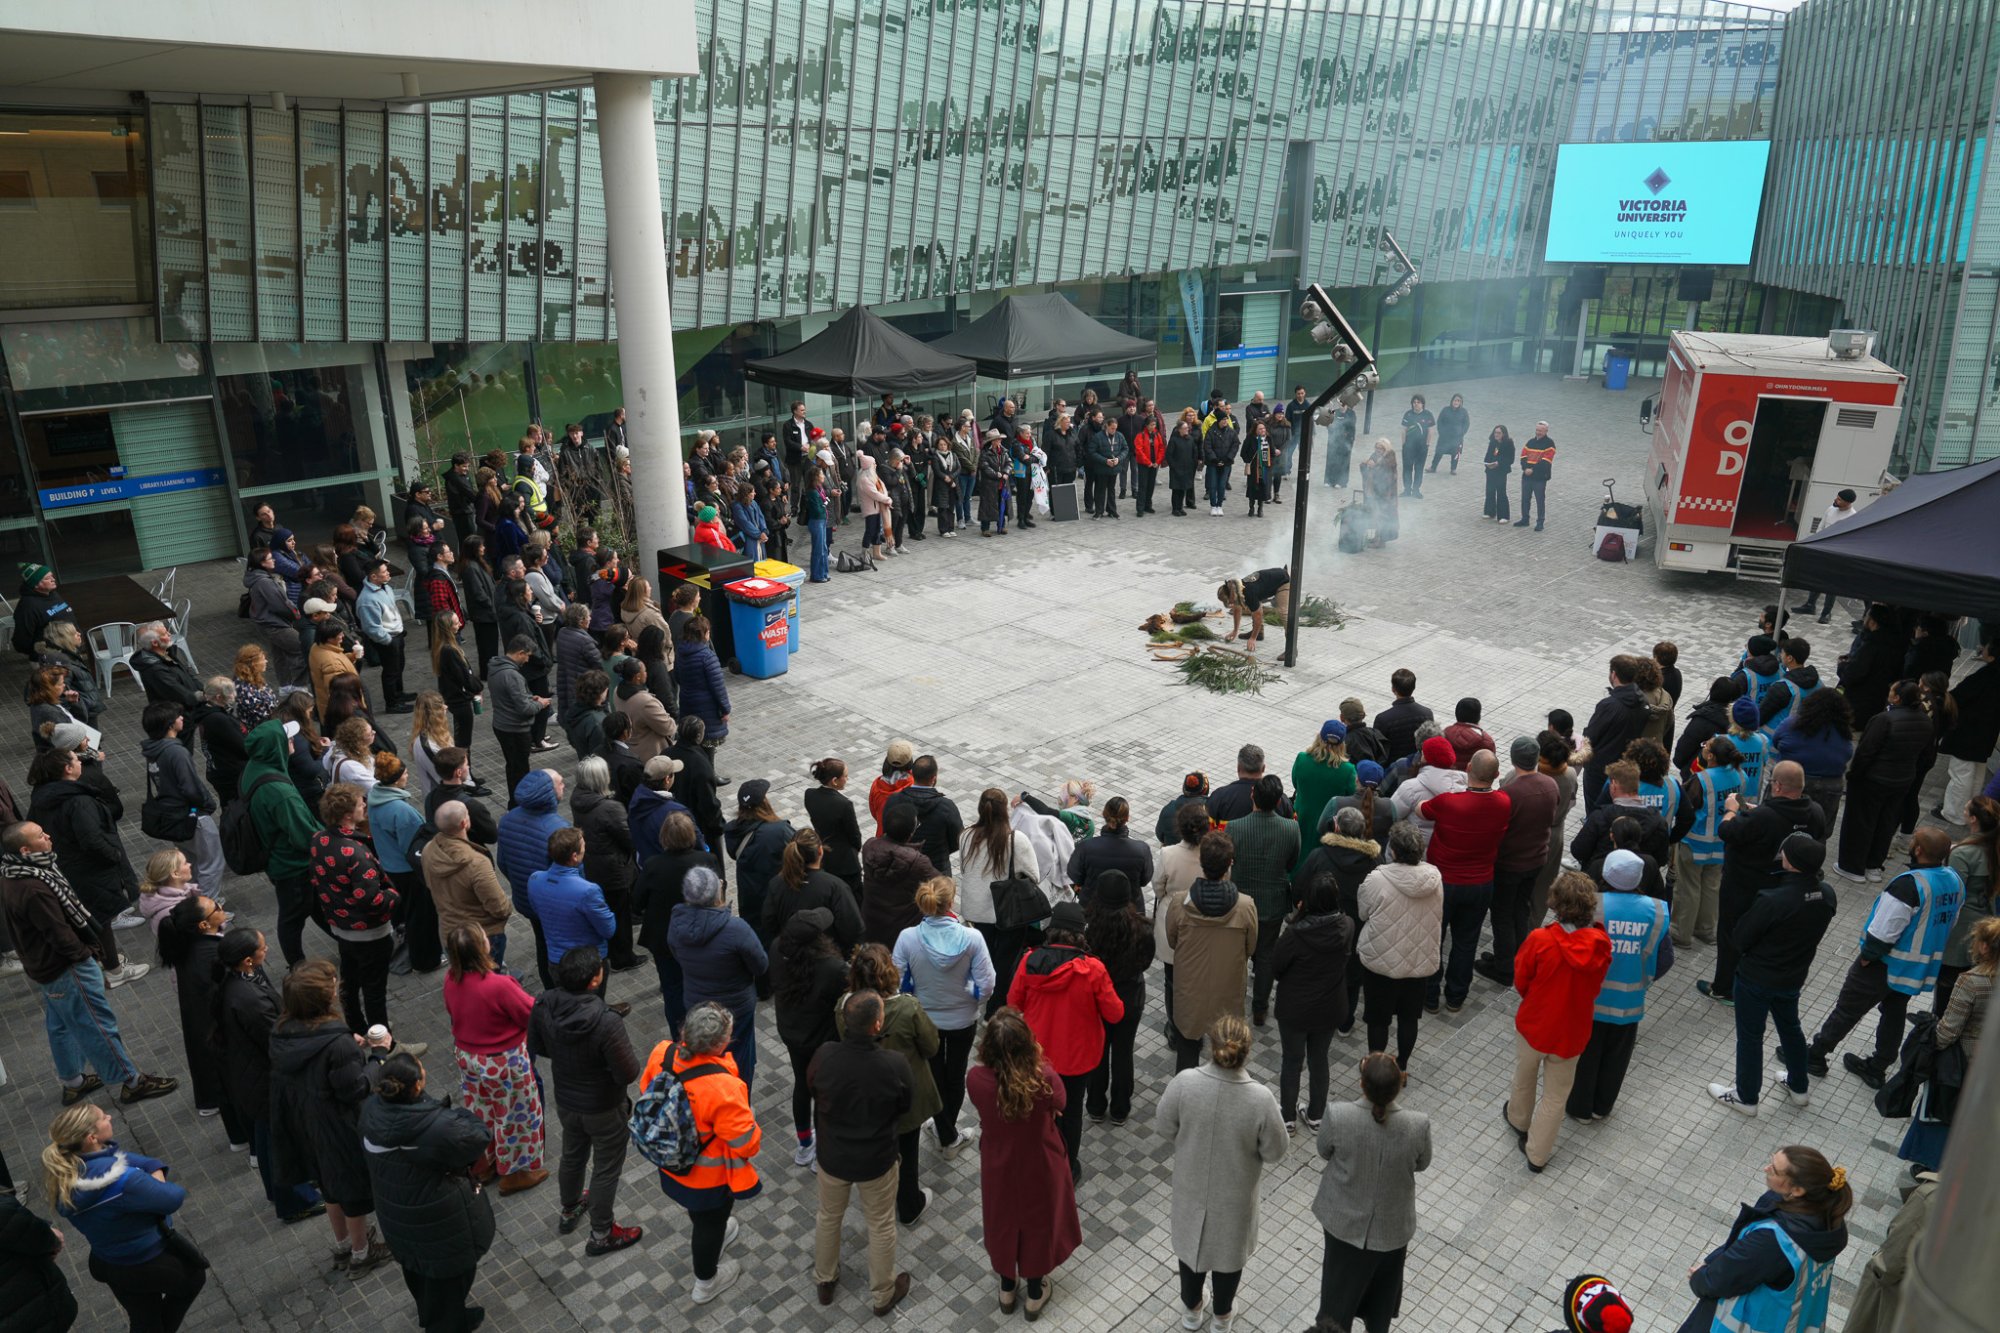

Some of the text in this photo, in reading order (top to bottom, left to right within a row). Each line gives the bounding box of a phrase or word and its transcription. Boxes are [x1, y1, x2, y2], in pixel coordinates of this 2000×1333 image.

[1619, 200, 1687, 211] VICTORIA
[1617, 213, 1686, 222] UNIVERSITY
[1614, 231, 1660, 239] UNIQUELY
[1716, 450, 1743, 476] D
[139, 478, 185, 490] LIBRARY/LEARNING
[49, 490, 88, 502] BUILDING
[89, 489, 95, 497] P
[761, 626, 788, 639] WASTE
[1639, 794, 1664, 806] VENT
[1607, 920, 1649, 936] EVENT
